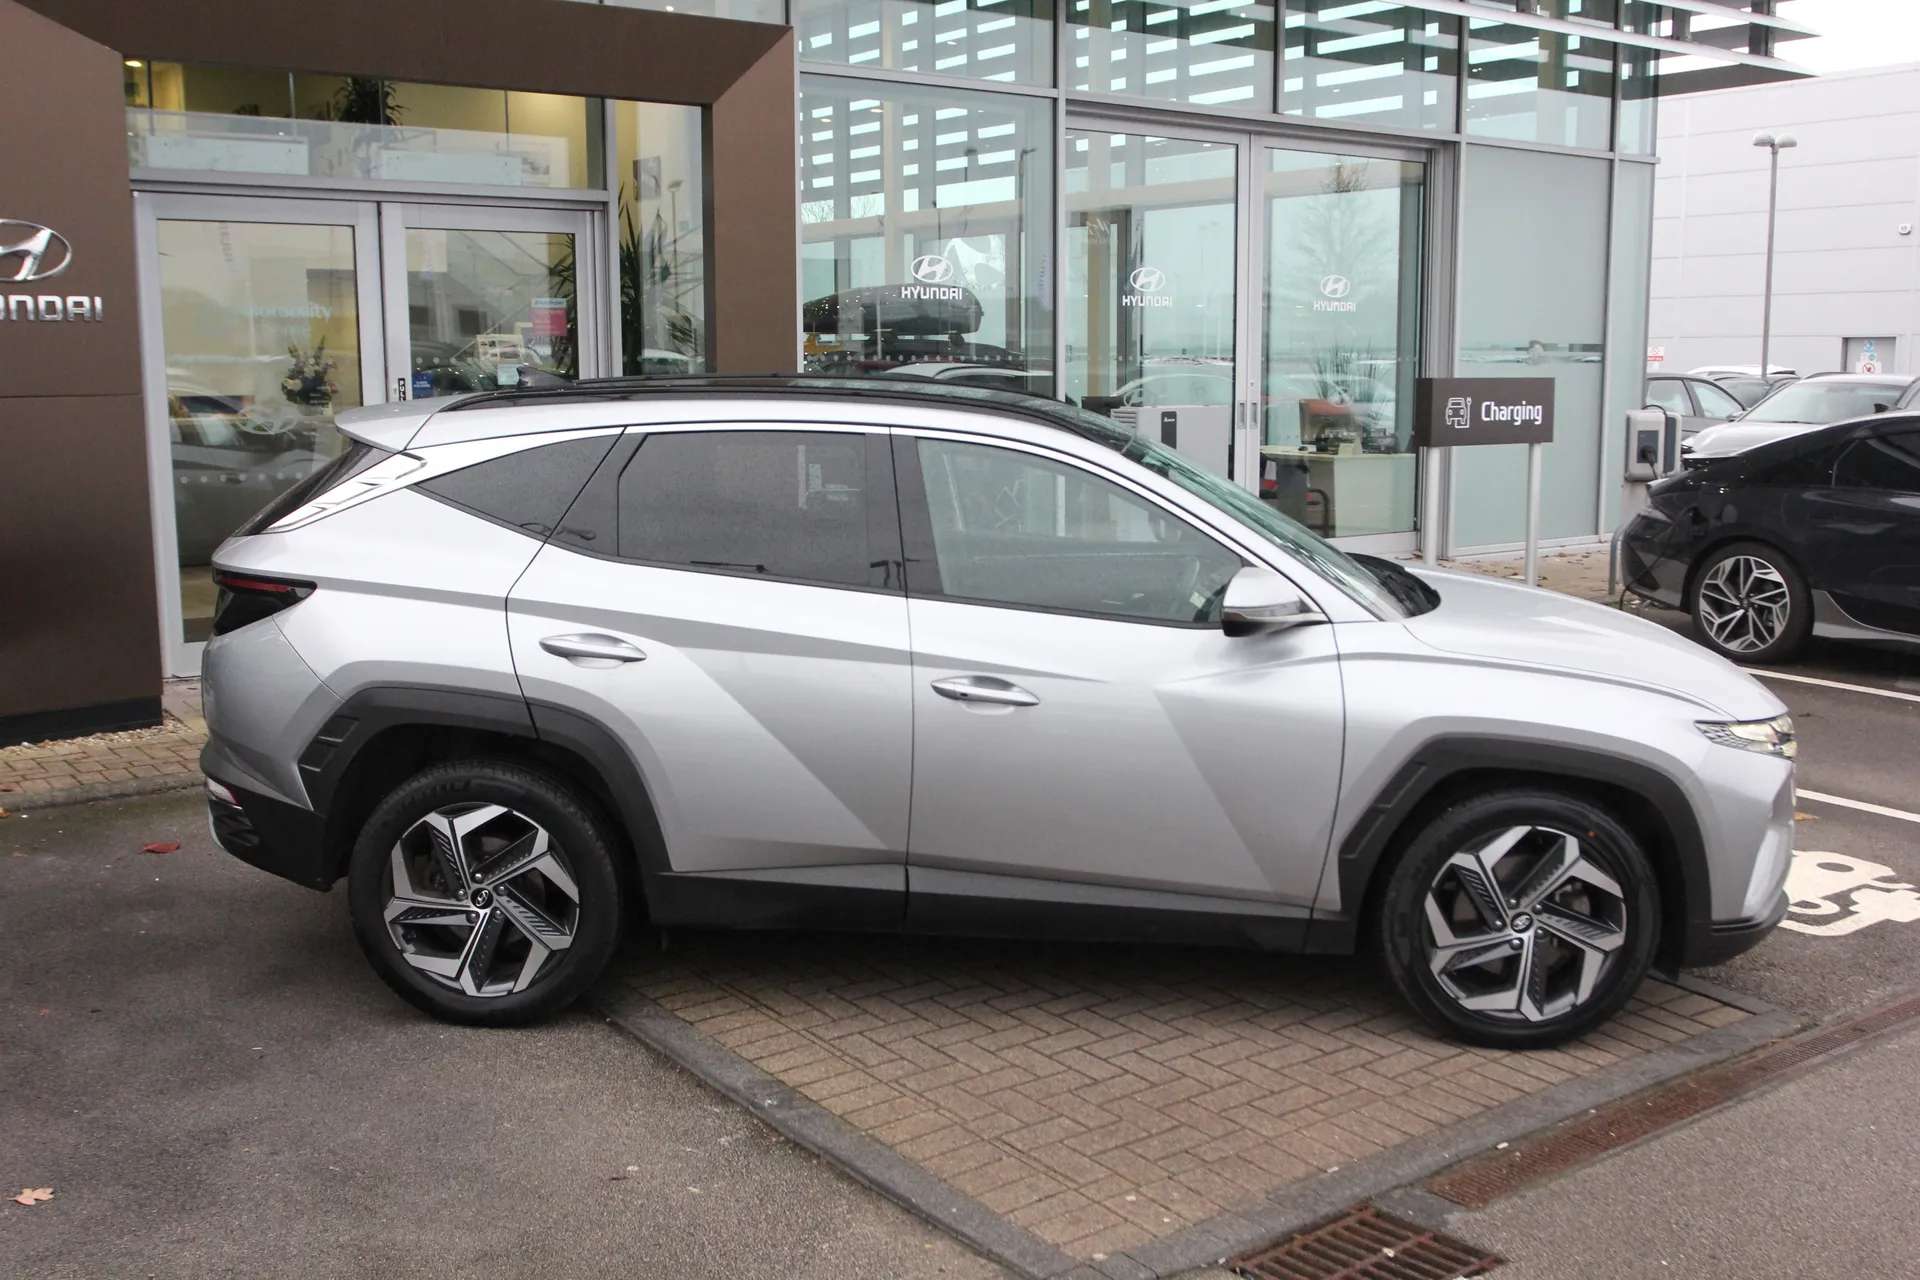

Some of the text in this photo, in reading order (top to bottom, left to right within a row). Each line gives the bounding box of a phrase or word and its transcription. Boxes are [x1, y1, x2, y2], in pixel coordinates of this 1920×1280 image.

[901, 285, 963, 300] HYUNDAI
[0, 294, 102, 321] NDAI
[1122, 295, 1173, 307] HYUNDAI
[1313, 300, 1356, 312] HYUNDAI
[1481, 400, 1543, 425] Charging
